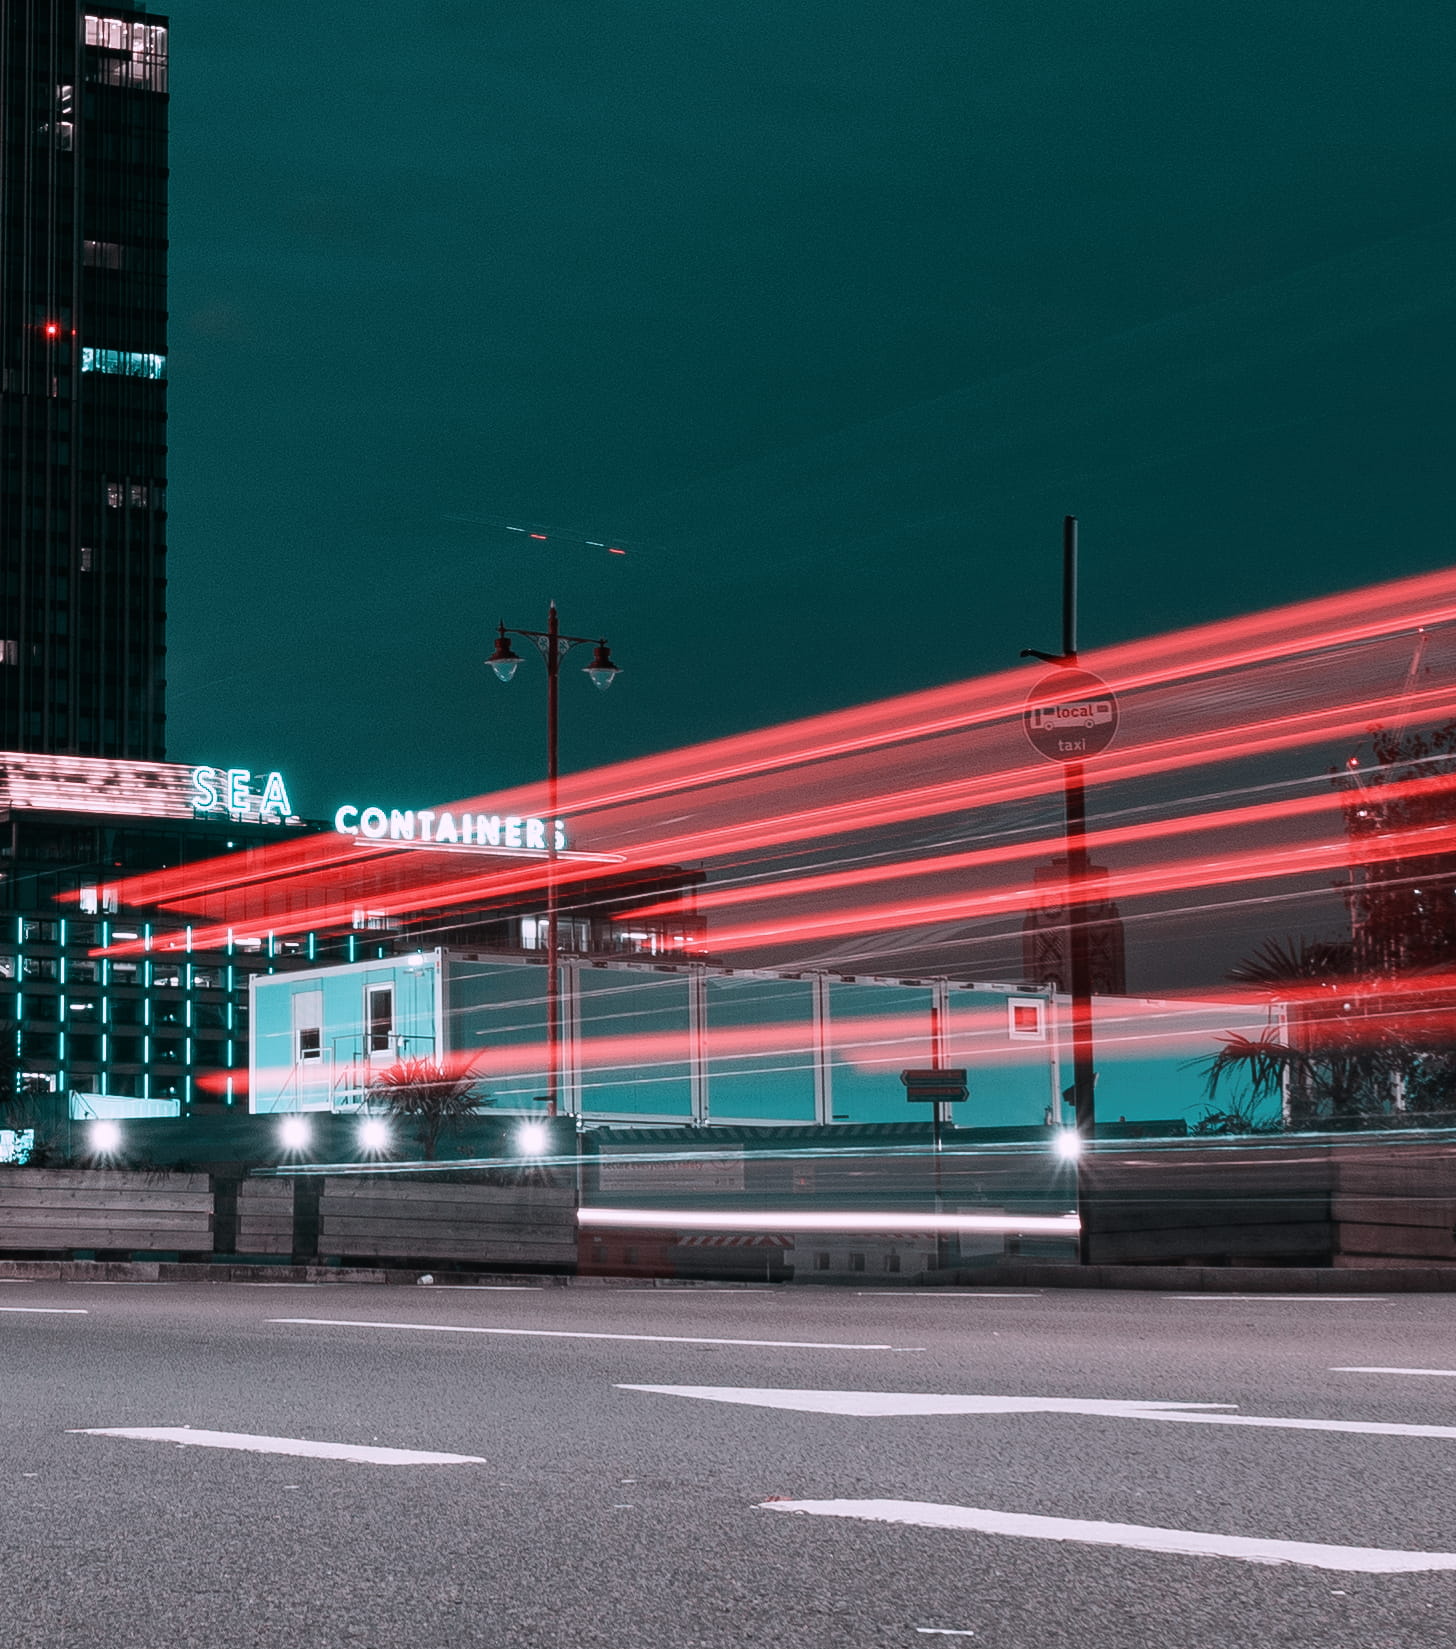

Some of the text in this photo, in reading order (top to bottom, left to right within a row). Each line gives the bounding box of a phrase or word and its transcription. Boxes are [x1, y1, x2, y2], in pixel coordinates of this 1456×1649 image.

[1056, 704, 1093, 718] local
[1058, 738, 1086, 751] taxi
[192, 766, 291, 815] SEA
